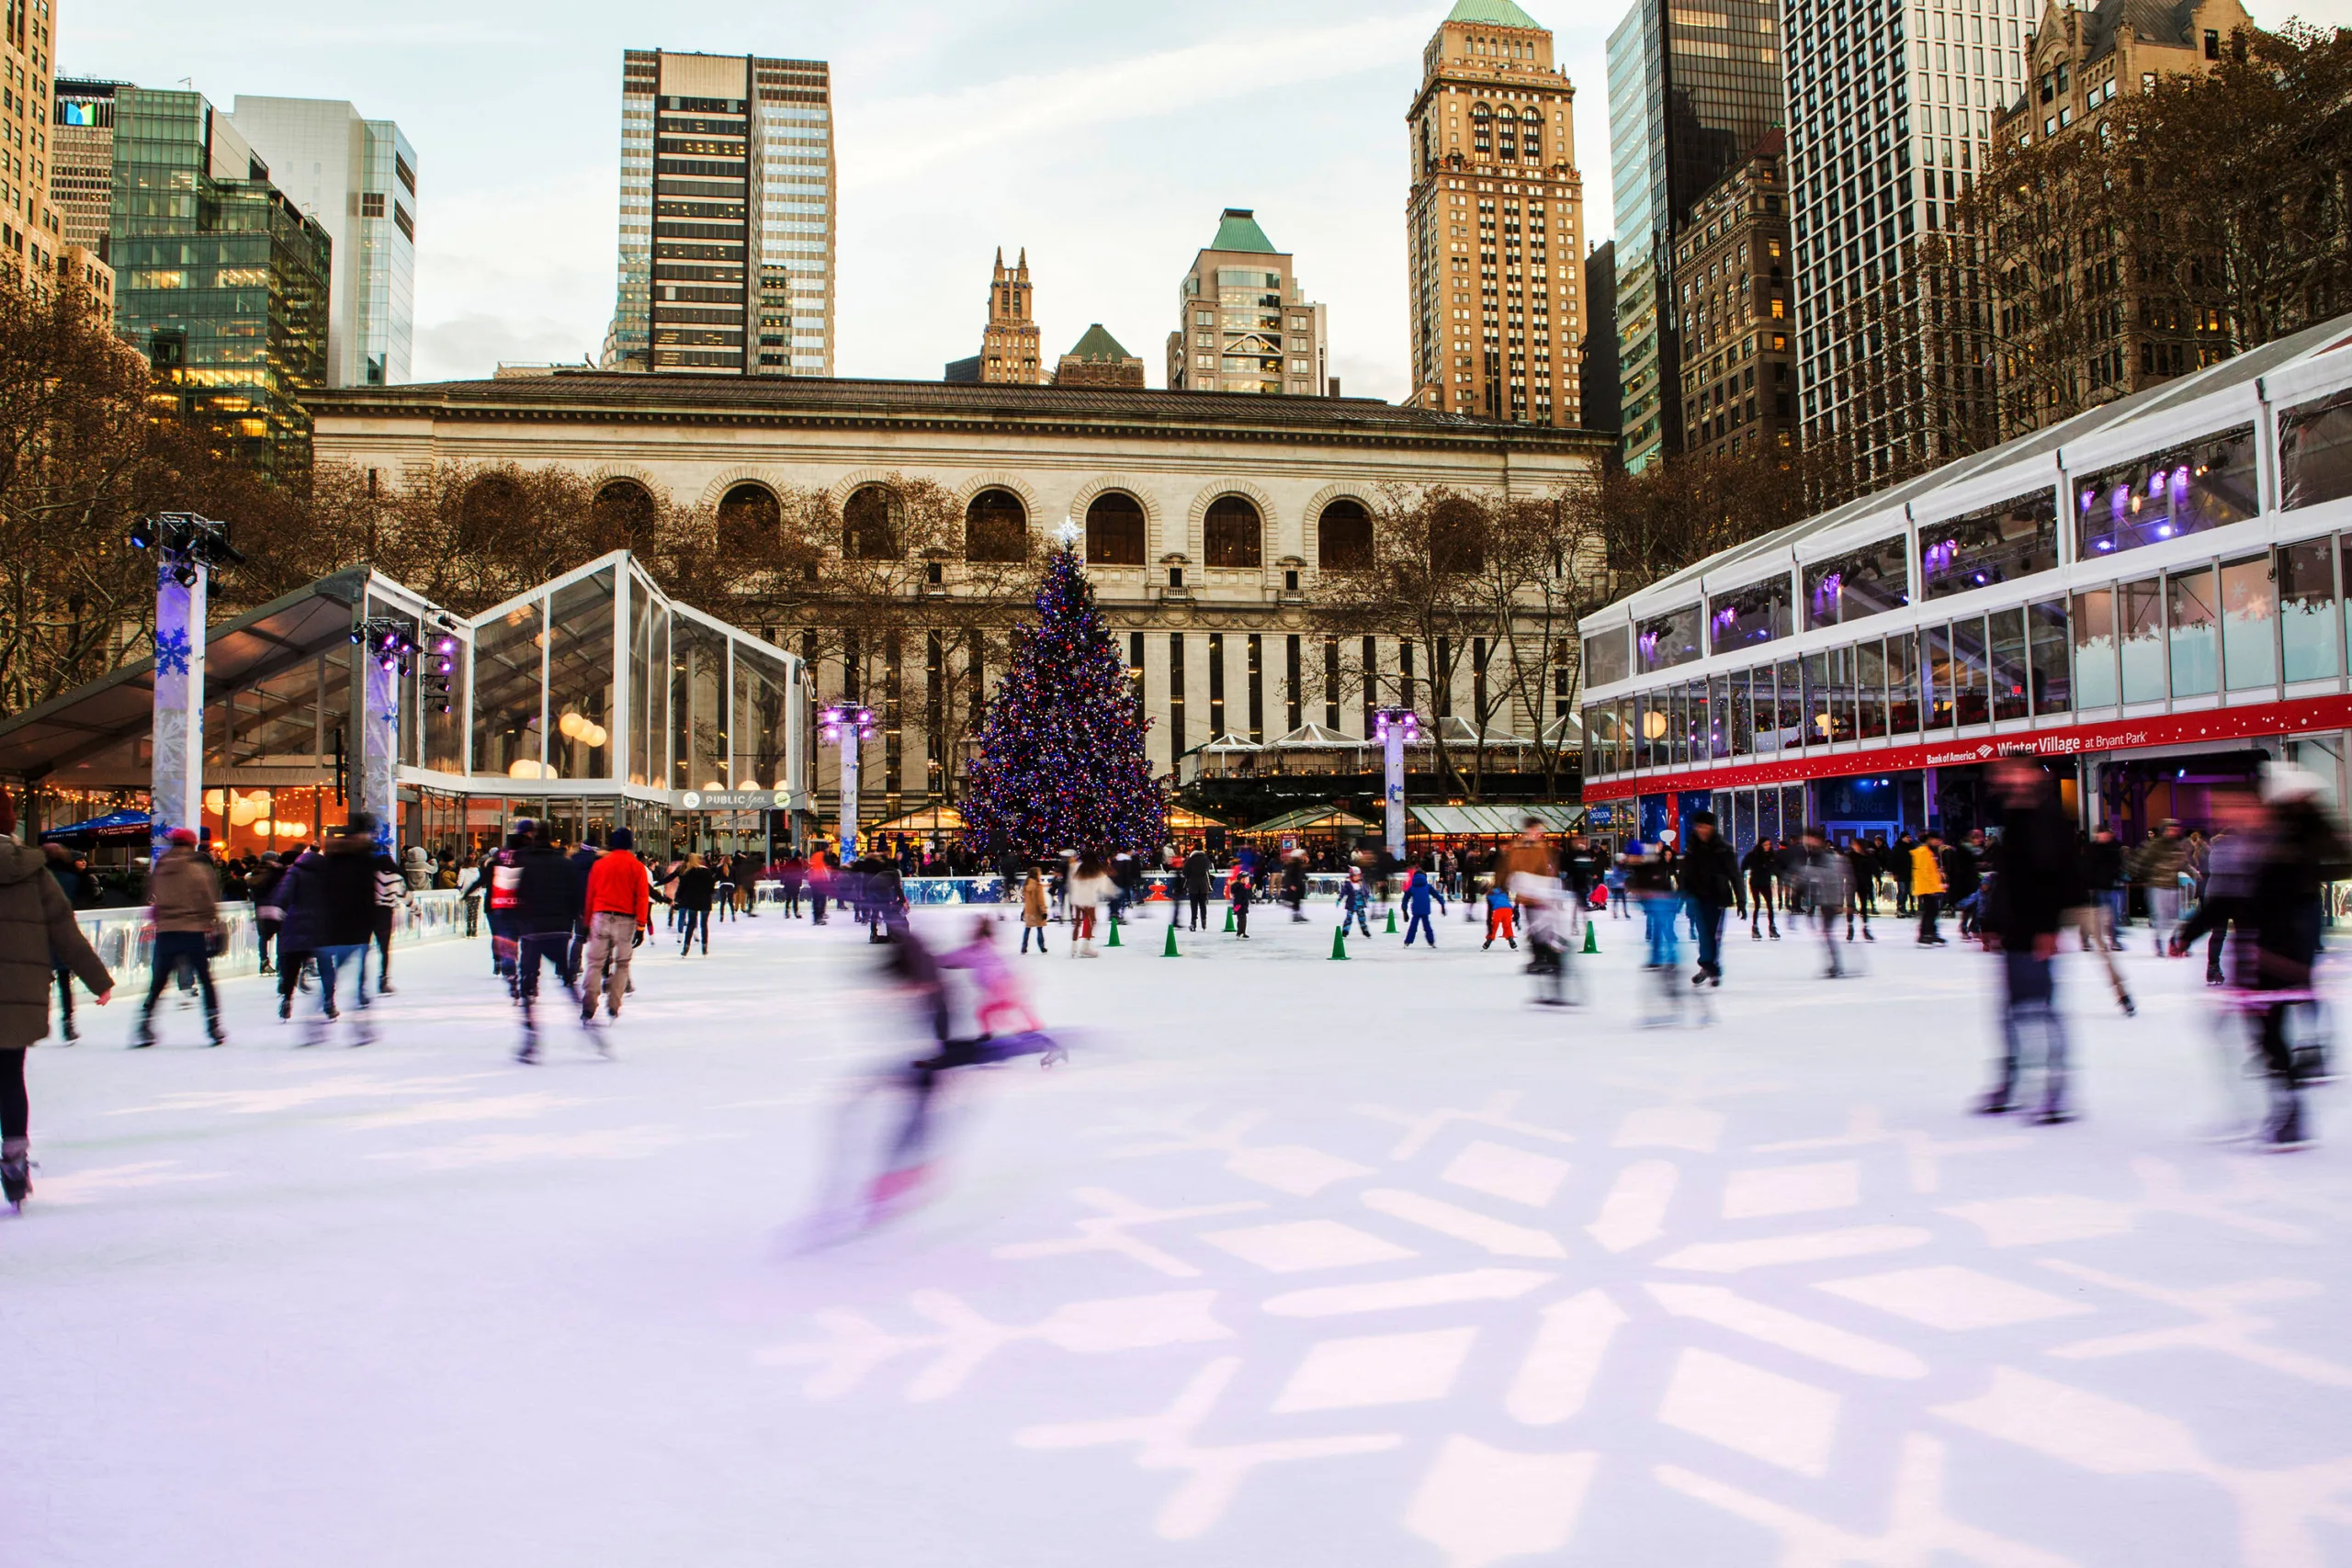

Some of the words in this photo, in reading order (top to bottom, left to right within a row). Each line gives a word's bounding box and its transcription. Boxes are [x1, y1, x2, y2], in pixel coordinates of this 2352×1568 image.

[1927, 754, 1944, 764] Bank
[1943, 753, 1950, 762] of
[1950, 750, 1976, 762] America
[1997, 741, 2037, 757] Winter
[2039, 736, 2081, 753] Village
[2085, 738, 2094, 749] at
[2096, 735, 2124, 750] Bryant
[2126, 731, 2146, 744] Park
[706, 795, 745, 805] PUBLIC
[1589, 811, 1611, 819] OVERLOOK
